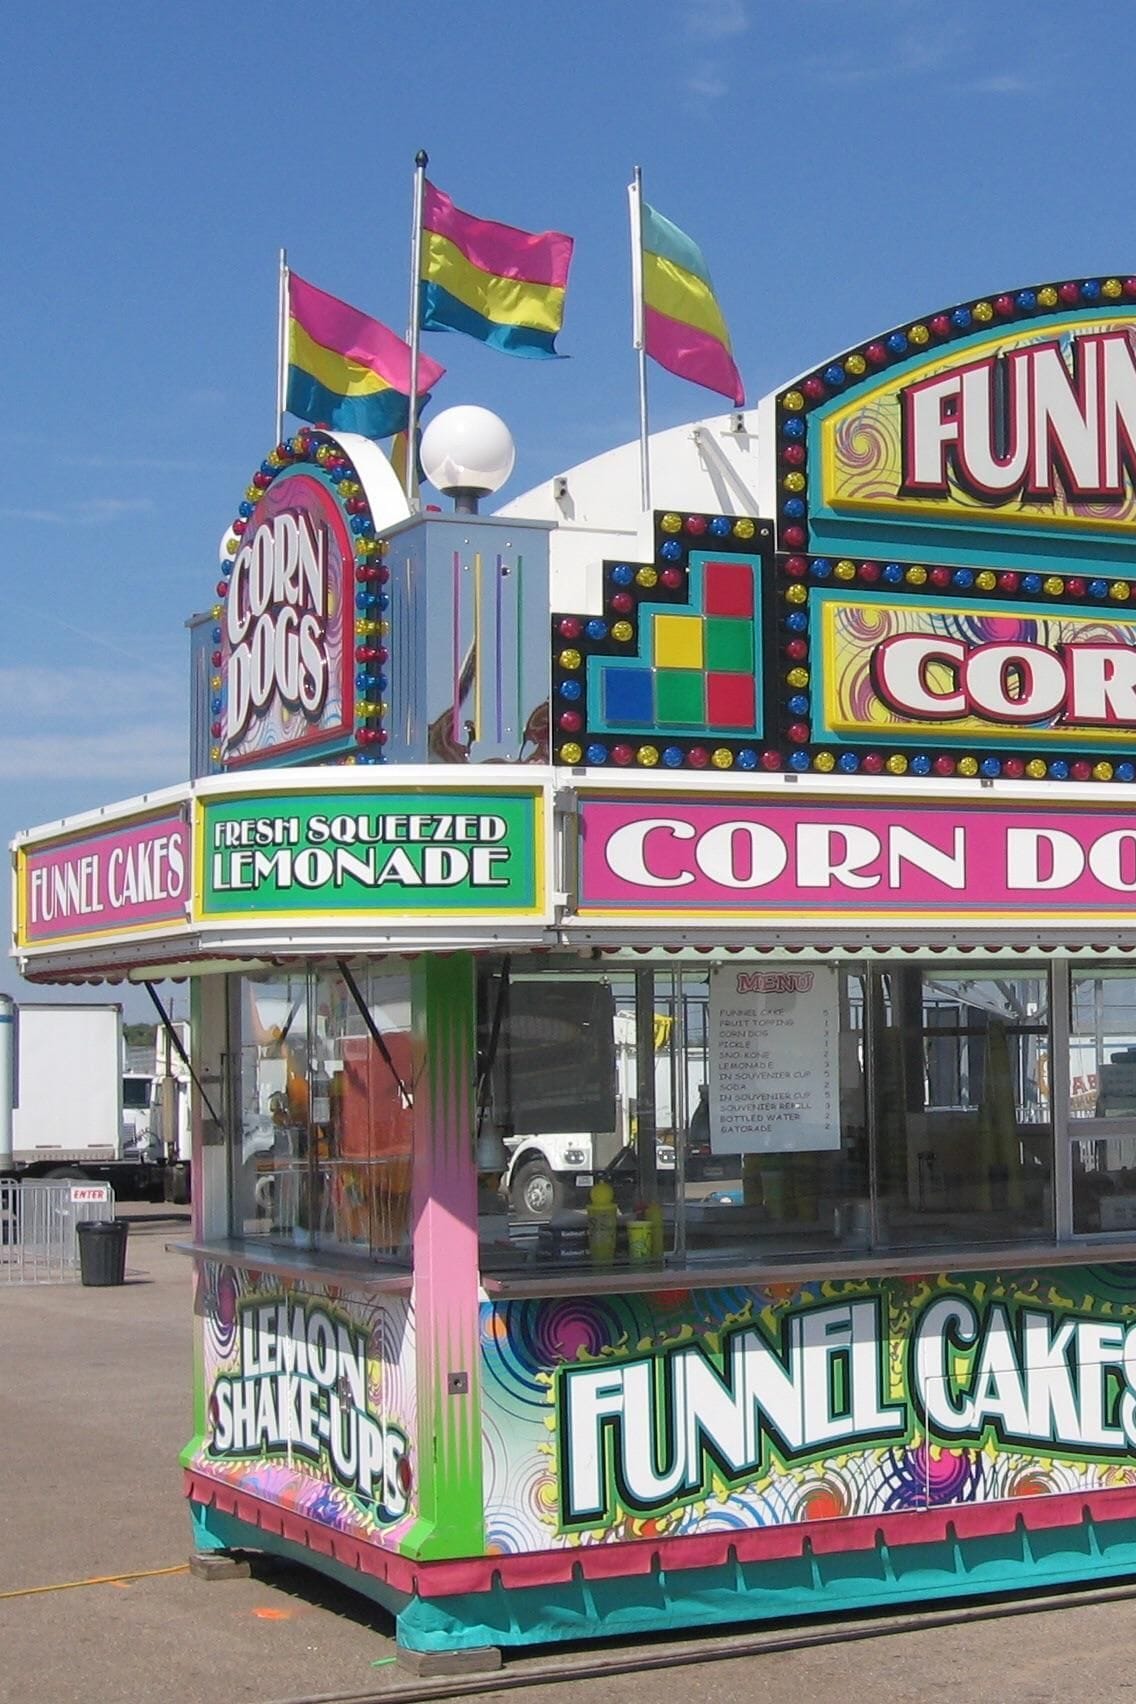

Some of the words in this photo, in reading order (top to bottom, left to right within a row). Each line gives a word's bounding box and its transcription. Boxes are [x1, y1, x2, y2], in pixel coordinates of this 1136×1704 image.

[226, 511, 328, 647] CORN
[226, 605, 328, 744] DOGS
[214, 817, 299, 848] FRESH
[306, 814, 507, 844] SQUEEZED
[604, 818, 966, 889] CORN
[31, 854, 104, 923] FUNNEL
[108, 832, 184, 908] CAKES
[213, 846, 511, 890] LEMONADE
[737, 971, 814, 993] MENU
[718, 1062, 774, 1070] LEMONADE
[720, 1114, 763, 1123] BOTTLED
[767, 1113, 801, 1121] WATER
[720, 1124, 773, 1134] GATORADE
[73, 1189, 105, 1199] ENTER
[241, 1304, 367, 1413] LEMON
[567, 1300, 908, 1518] FUNNEL
[213, 1374, 408, 1516] SHAKE-UPS
